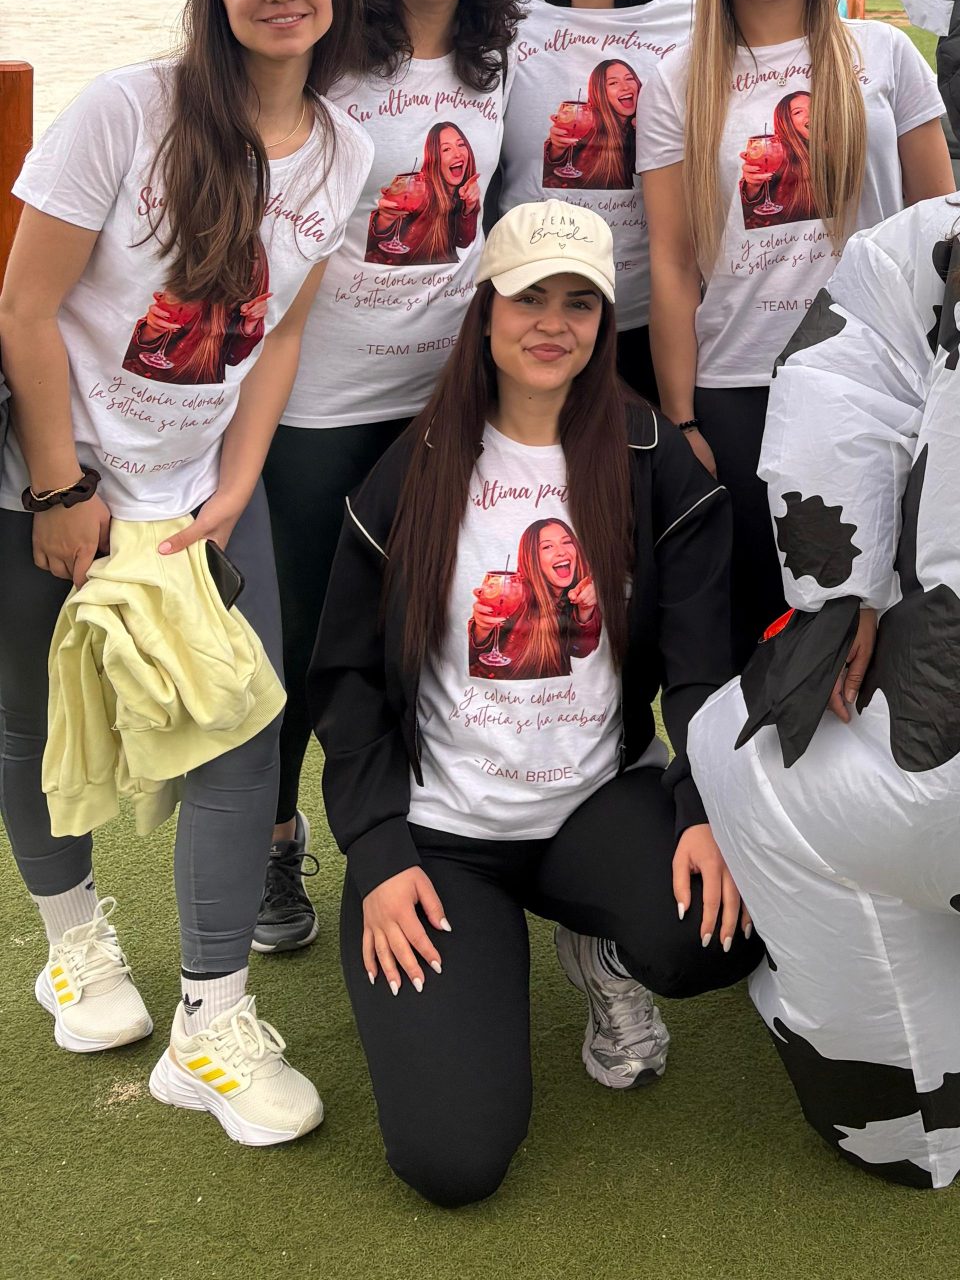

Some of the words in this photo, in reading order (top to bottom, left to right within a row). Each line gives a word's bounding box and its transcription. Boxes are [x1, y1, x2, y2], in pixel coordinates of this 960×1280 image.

[517, 41, 540, 62] Su
[544, 28, 599, 52] última
[602, 30, 676, 60] putivuel
[378, 89, 431, 117] última
[530, 226, 594, 244] Bride
[792, 254, 805, 267] se
[809, 249, 826, 263] ha
[406, 297, 424, 311] se
[88, 382, 106, 398] la
[157, 418, 178, 432] se
[180, 416, 198, 430] ha
[516, 719, 533, 734] se
[537, 712, 552, 730] ha
